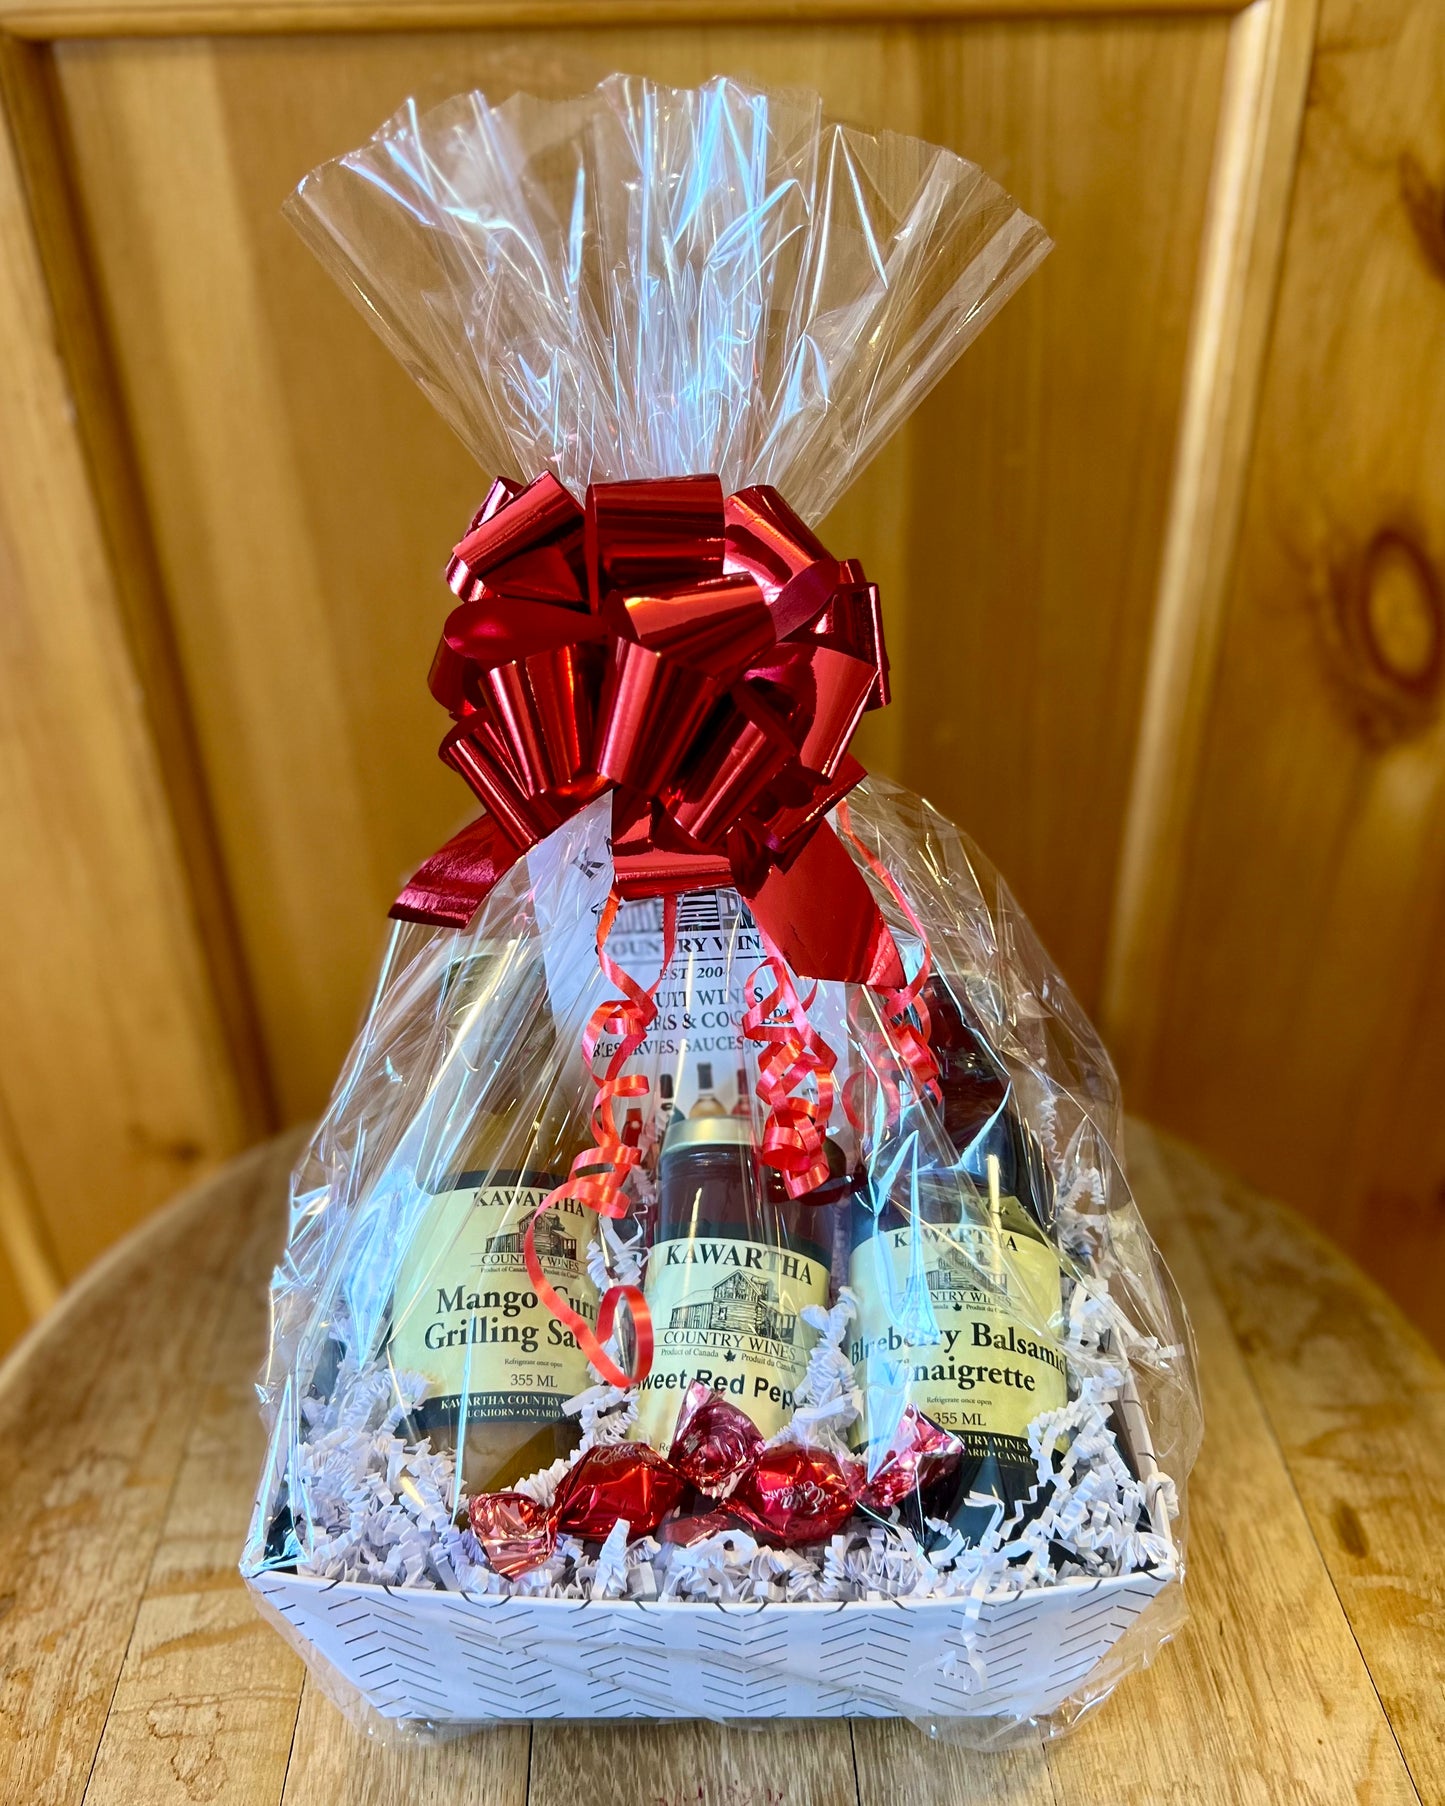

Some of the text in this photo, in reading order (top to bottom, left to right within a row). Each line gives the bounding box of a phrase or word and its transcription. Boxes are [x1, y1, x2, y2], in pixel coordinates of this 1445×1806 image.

[547, 1256, 580, 1272] WINES
[665, 1242, 813, 1287] KAWARTHA
[436, 1284, 539, 1318] Mango
[424, 1316, 540, 1353] Grilling
[664, 1329, 797, 1361] COUNTRY WINES
[970, 1321, 1066, 1377] Balsamic
[661, 1348, 684, 1357] Product
[685, 1348, 693, 1357] of
[693, 1349, 719, 1358] Canada
[741, 1353, 765, 1365] Produit
[767, 1357, 775, 1366] du
[510, 1374, 558, 1388] 355 ML
[637, 1368, 687, 1391] weet
[695, 1369, 745, 1395] Red
[507, 1395, 560, 1407] COUNTRY
[926, 1396, 960, 1405] Refrigerate
[467, 1407, 515, 1418] UCKHORN
[521, 1407, 561, 1418] ONTARIO
[934, 1412, 987, 1427] 355 ML
[993, 1437, 1029, 1452] WINES
